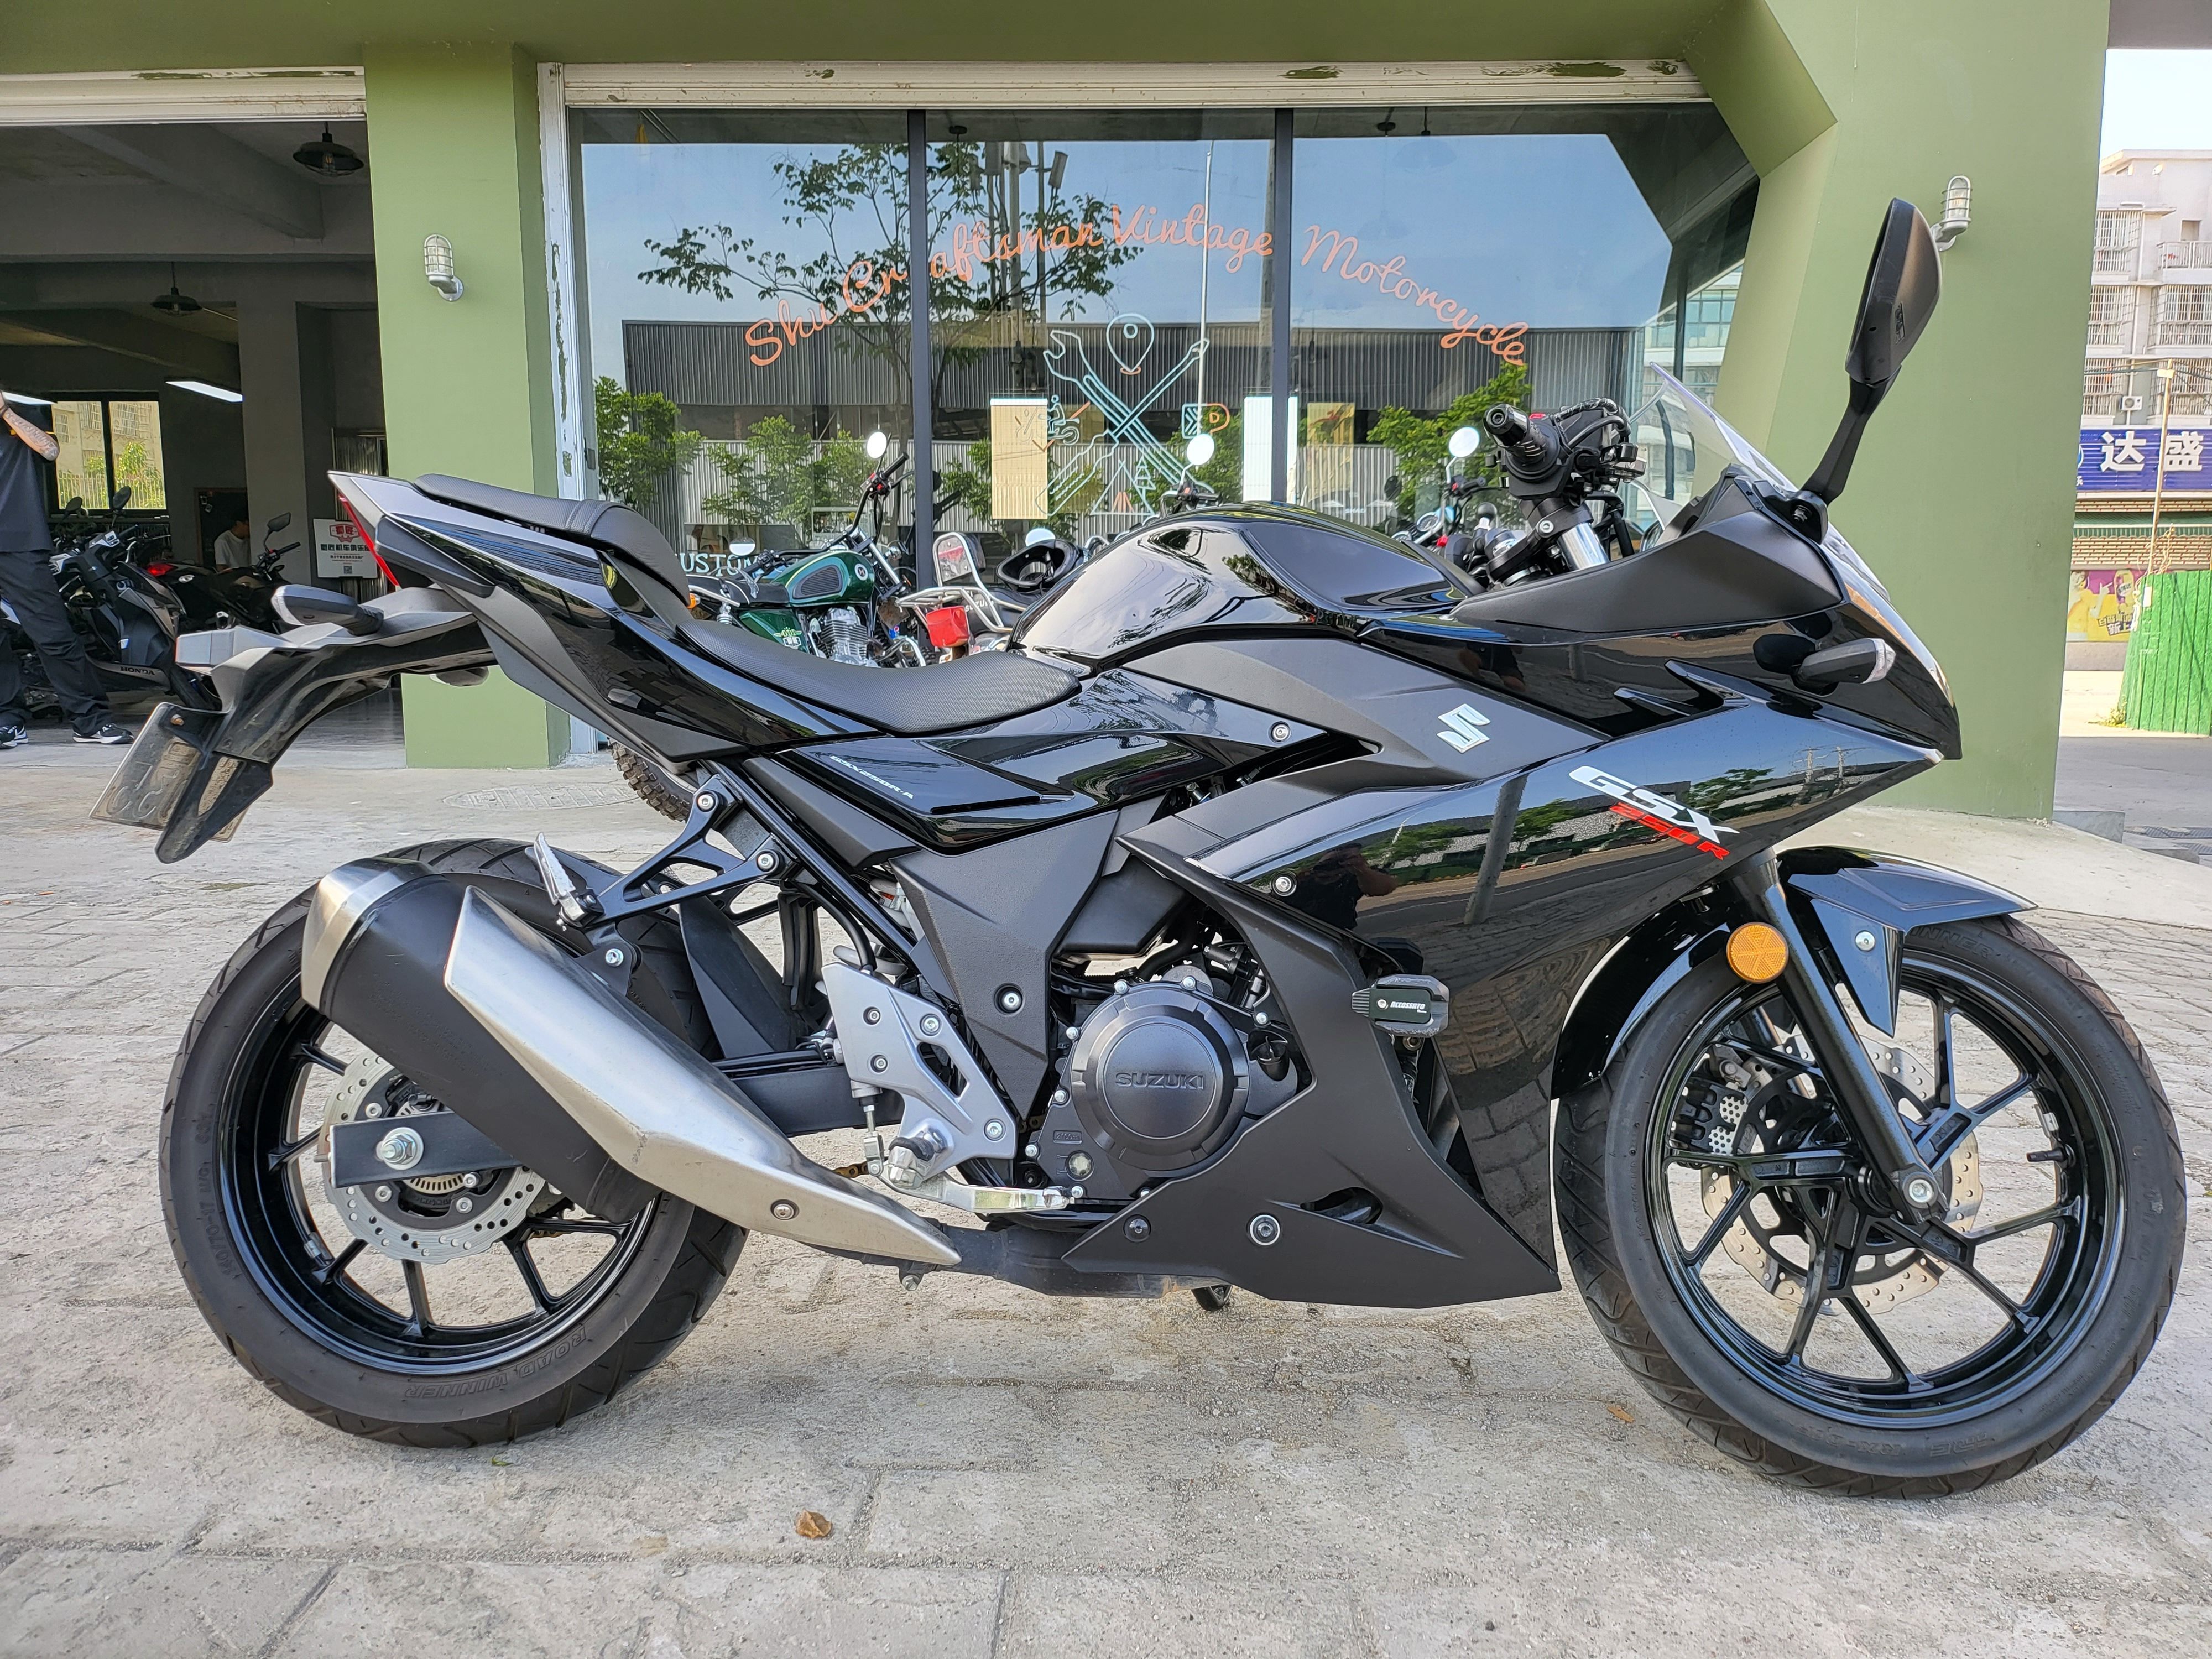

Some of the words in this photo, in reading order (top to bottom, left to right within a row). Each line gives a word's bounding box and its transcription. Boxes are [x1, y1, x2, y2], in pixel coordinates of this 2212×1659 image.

[745, 299, 839, 366] Shu
[842, 220, 1103, 313] Craftsman
[1111, 203, 1274, 273] Vintage
[1301, 225, 1529, 366] Motorcycle
[2100, 430, 2204, 473] 达盛
[677, 552, 759, 577] USTO
[119, 666, 155, 676] HONDA
[830, 755, 914, 800] GSX250R-A
[1569, 765, 1740, 844] GSX
[1910, 925, 1995, 959] INNER
[1390, 1001, 1426, 1010] ACCOSSATO
[1115, 1072, 1204, 1090] SUZUKI
[514, 1324, 587, 1378] ROAD
[405, 1373, 508, 1399] WINNER
